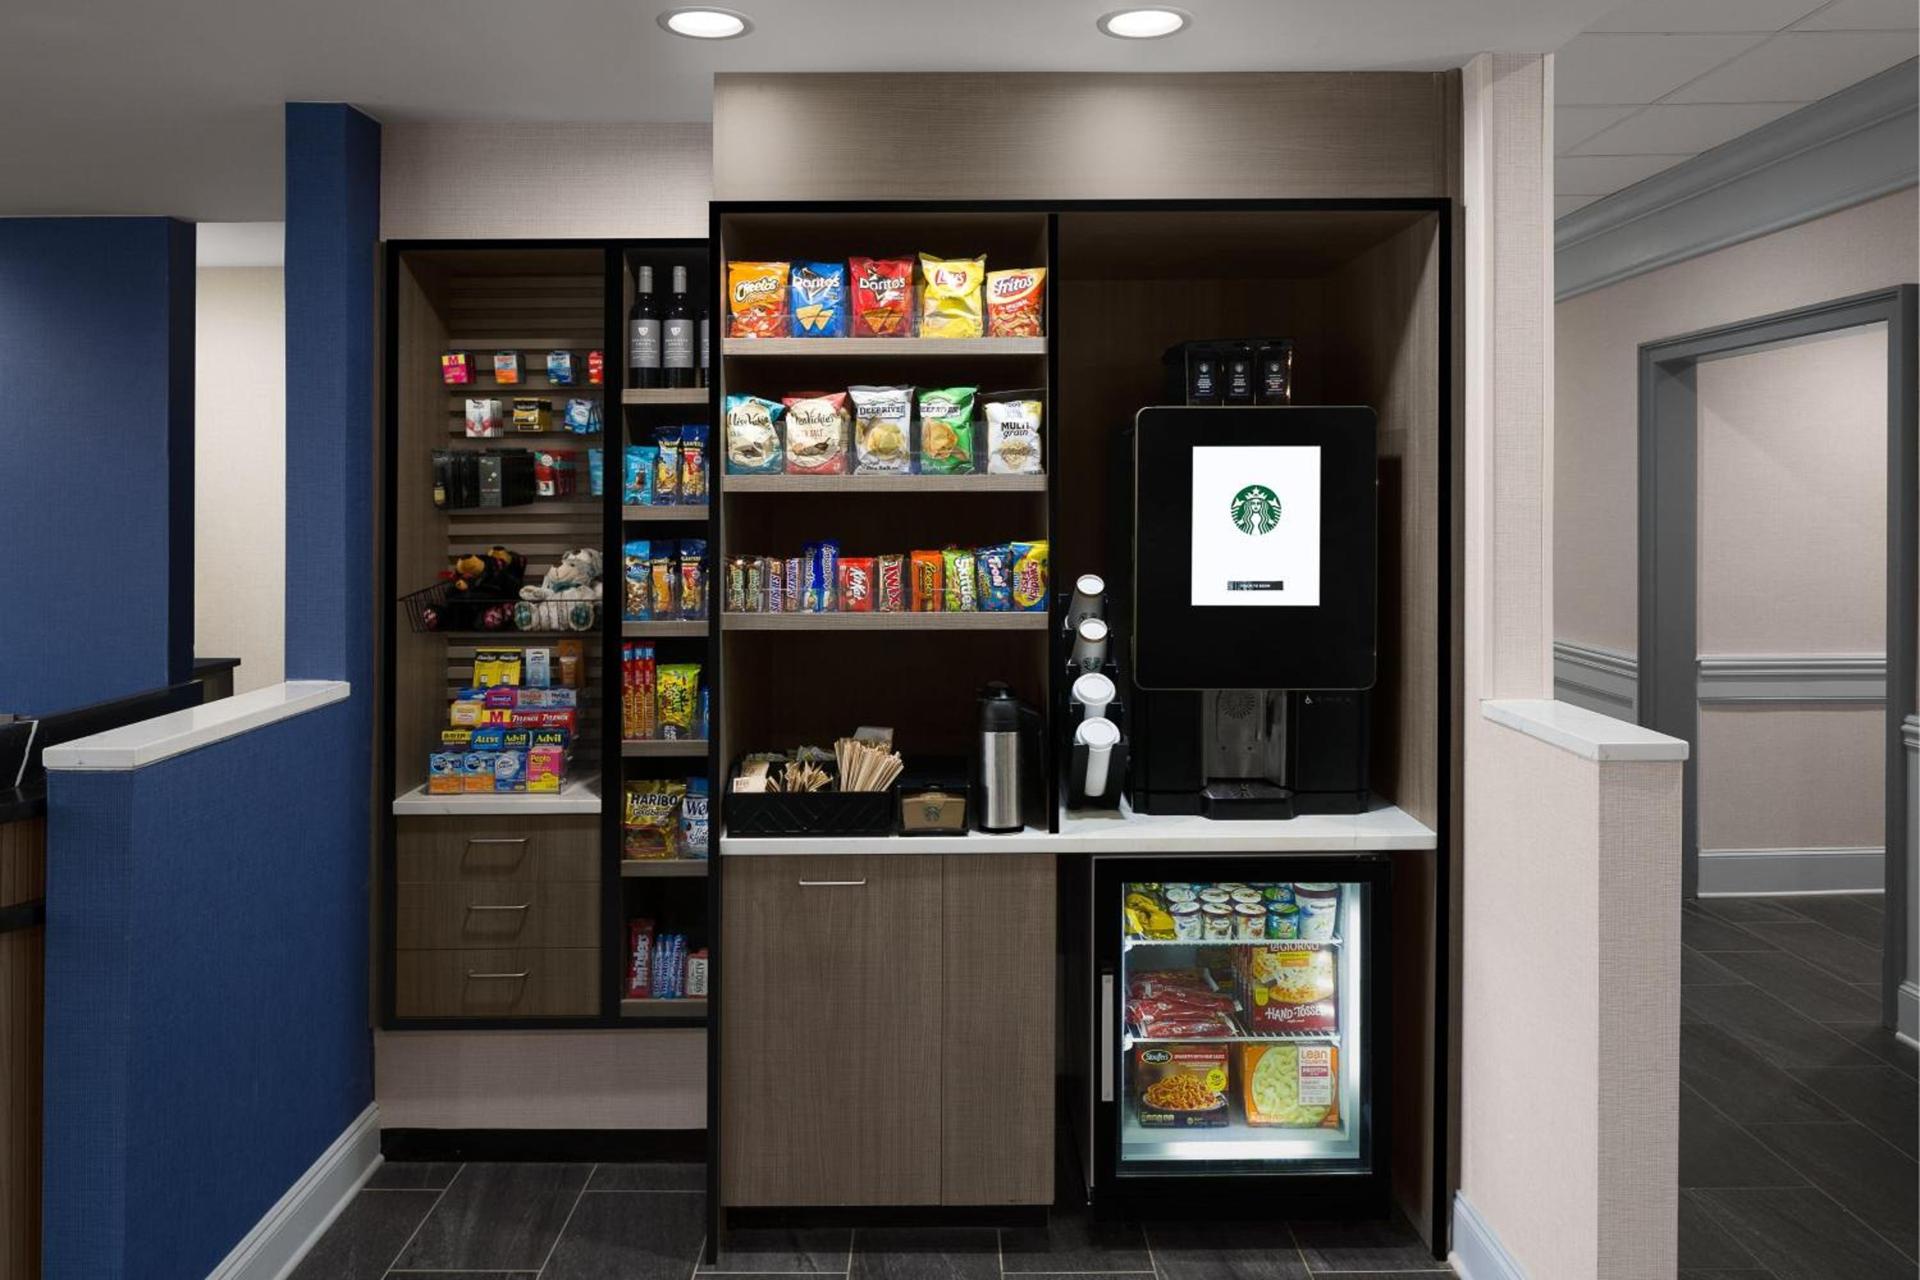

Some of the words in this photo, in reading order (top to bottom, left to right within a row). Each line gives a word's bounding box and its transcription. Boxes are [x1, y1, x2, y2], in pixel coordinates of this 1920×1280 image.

[735, 276, 779, 302] Cheetos
[792, 274, 841, 290] Doritos
[859, 276, 906, 291] Doritos
[993, 275, 1034, 295] Fritos
[955, 557, 973, 612] Skittles
[542, 713, 569, 722] TYLENOL
[505, 733, 528, 743] Advil
[536, 733, 562, 743] Advil
[630, 792, 678, 807] HARIBO
[1301, 1050, 1328, 1060] Lean
